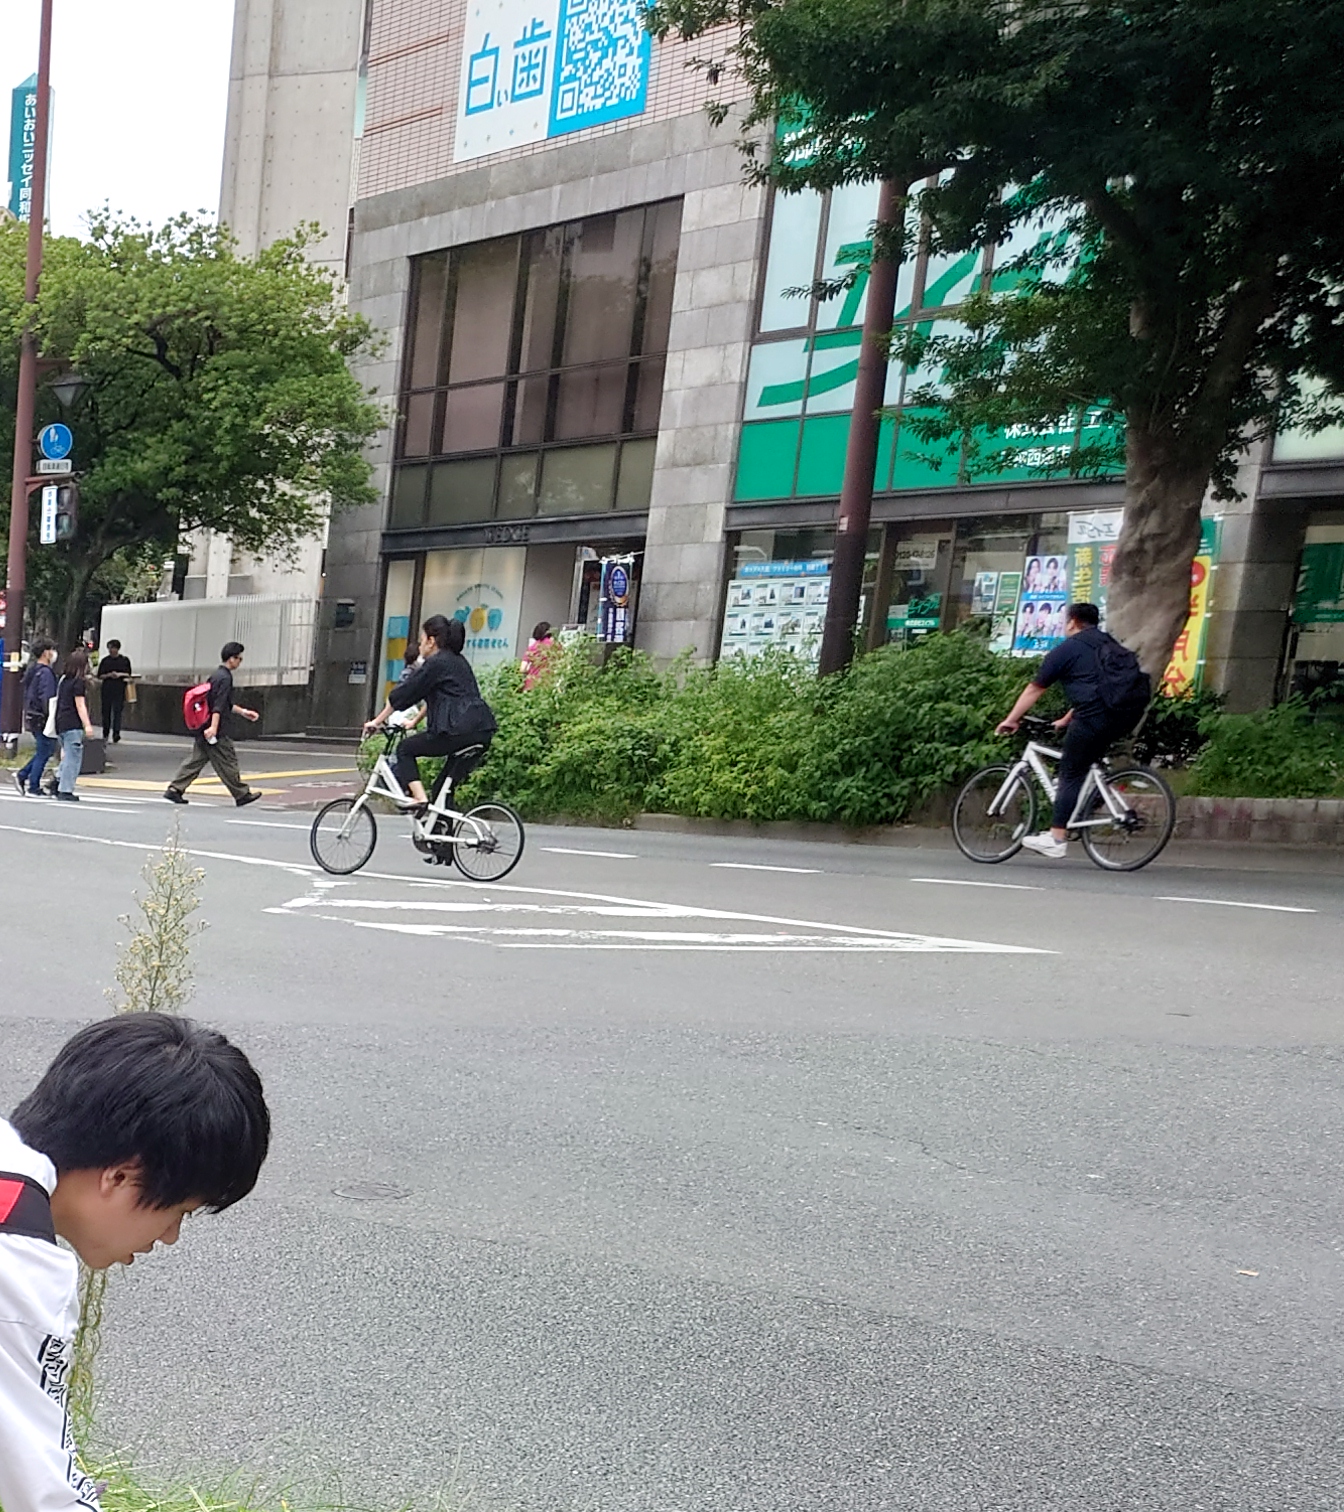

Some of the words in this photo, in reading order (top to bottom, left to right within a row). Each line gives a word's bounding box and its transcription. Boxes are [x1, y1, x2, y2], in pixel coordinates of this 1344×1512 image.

[465, 17, 551, 118] 白い歯
[18, 93, 37, 222] あいおいニッセイ同和
